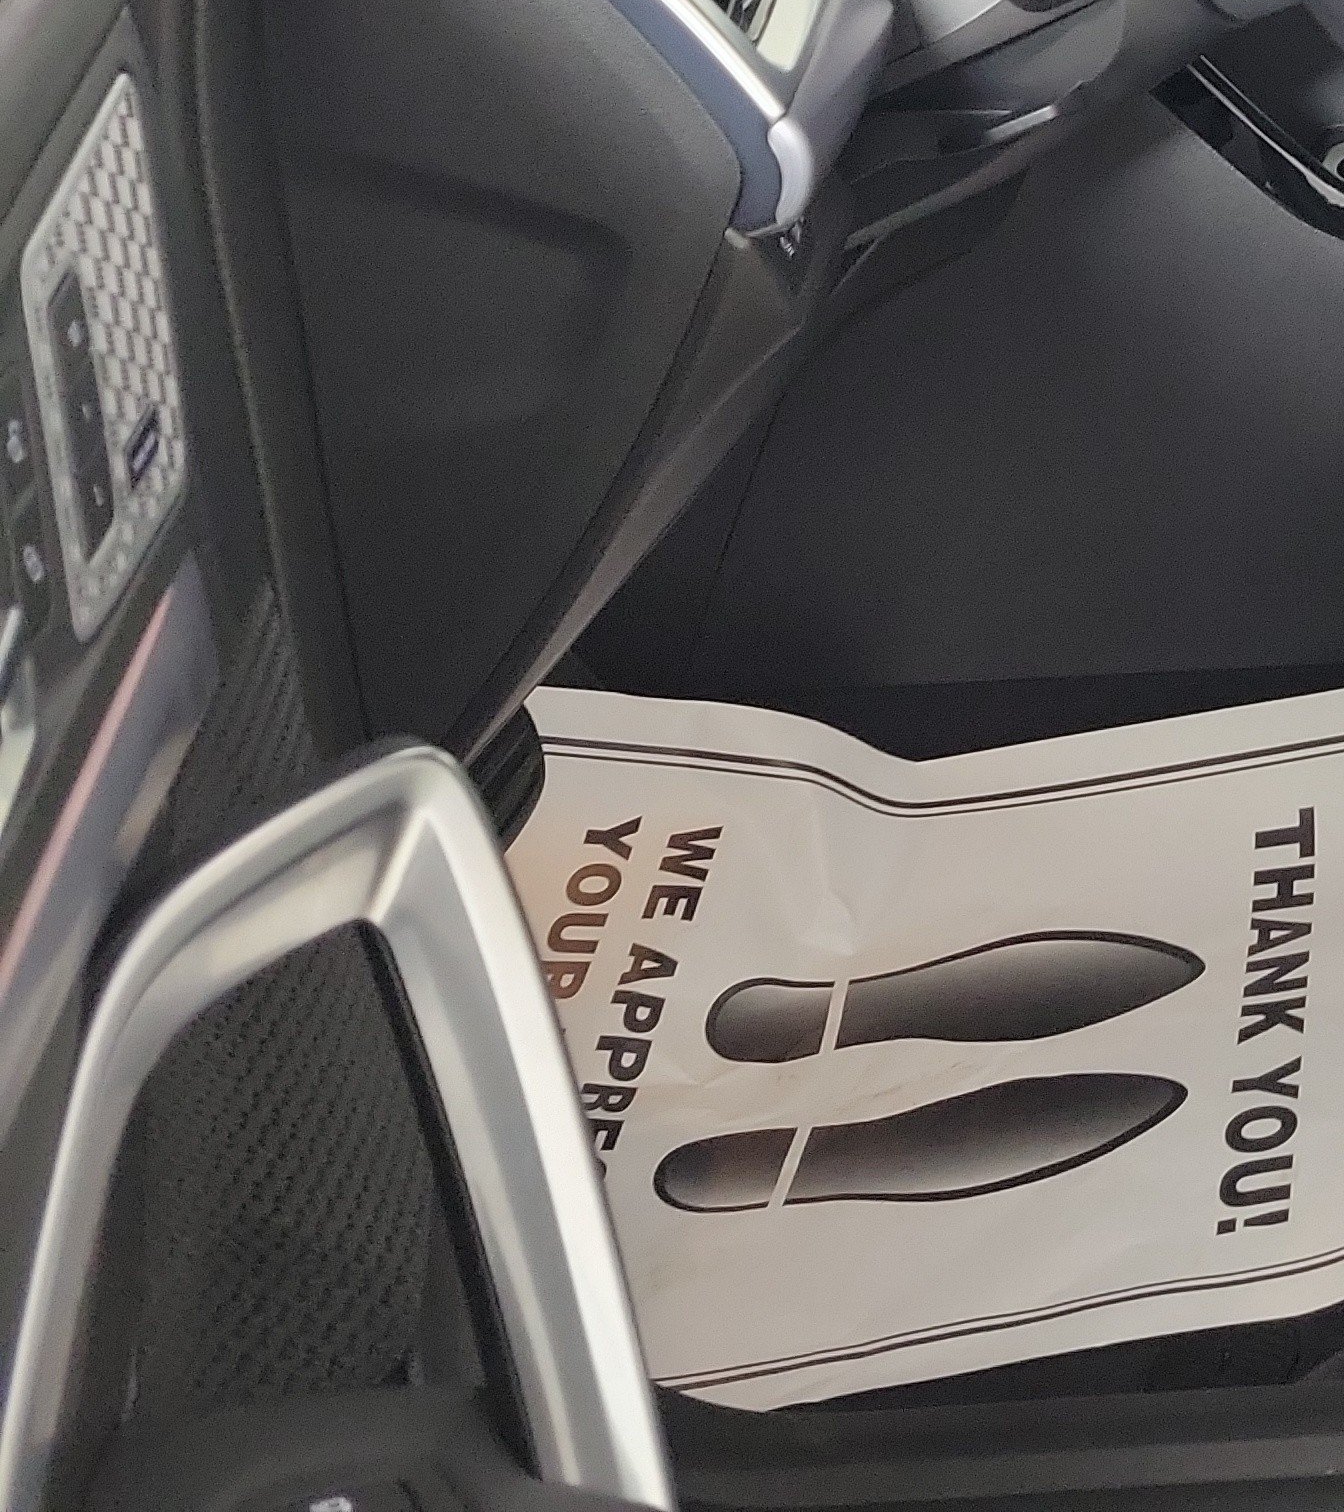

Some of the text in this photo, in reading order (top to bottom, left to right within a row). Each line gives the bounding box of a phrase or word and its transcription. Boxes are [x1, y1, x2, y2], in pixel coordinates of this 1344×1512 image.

[580, 825, 725, 1182] WE APPRE
[1215, 806, 1316, 1237] THANK YOU!
